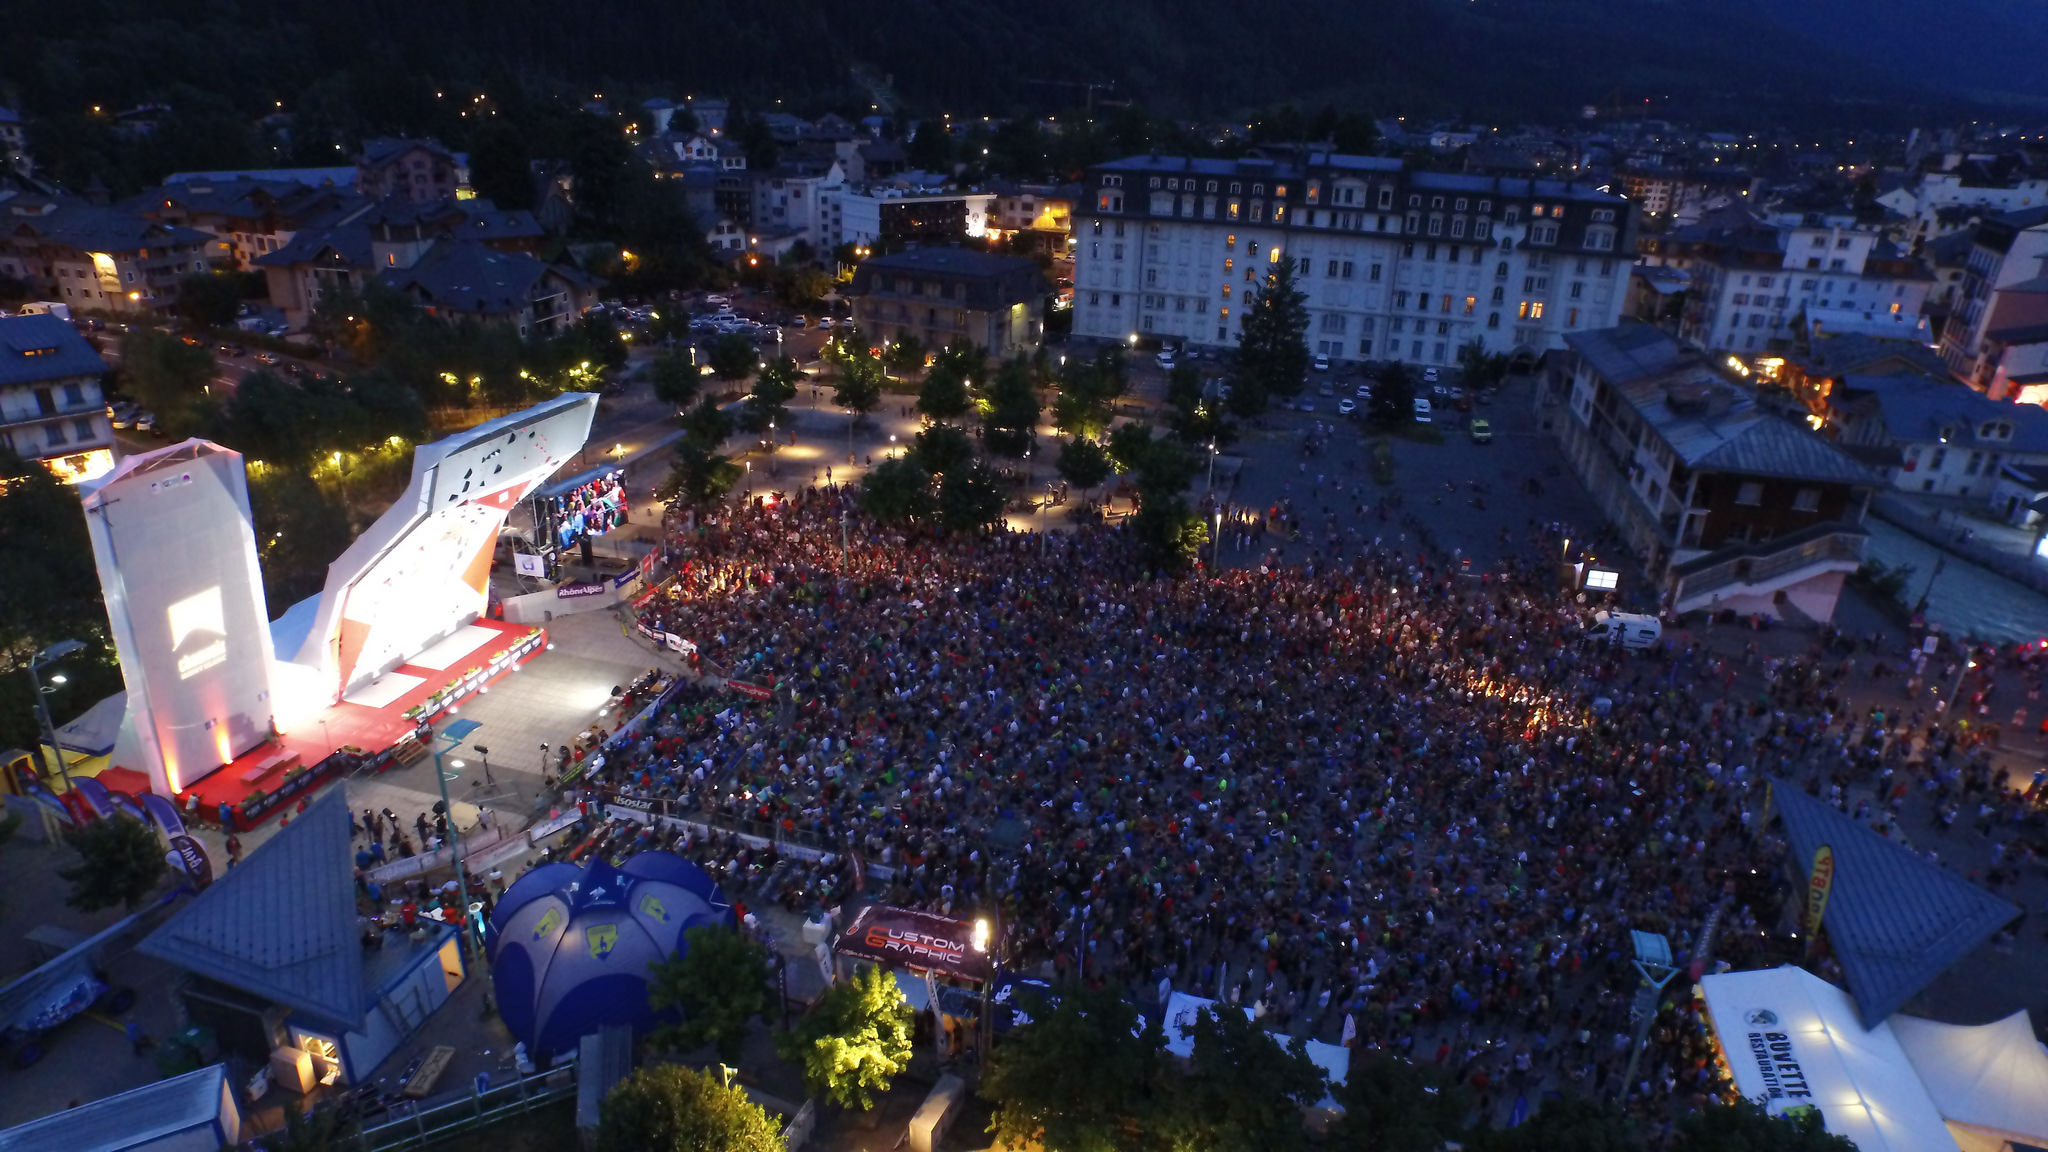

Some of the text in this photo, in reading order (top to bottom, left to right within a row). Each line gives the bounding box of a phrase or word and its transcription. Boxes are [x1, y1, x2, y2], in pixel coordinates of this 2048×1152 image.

[865, 937, 963, 964] GRAPHIC
[867, 926, 965, 953] CUSTOM
[1748, 1032, 1784, 1098] RESTAURATION
[1765, 1032, 1812, 1098] BUVETTE
